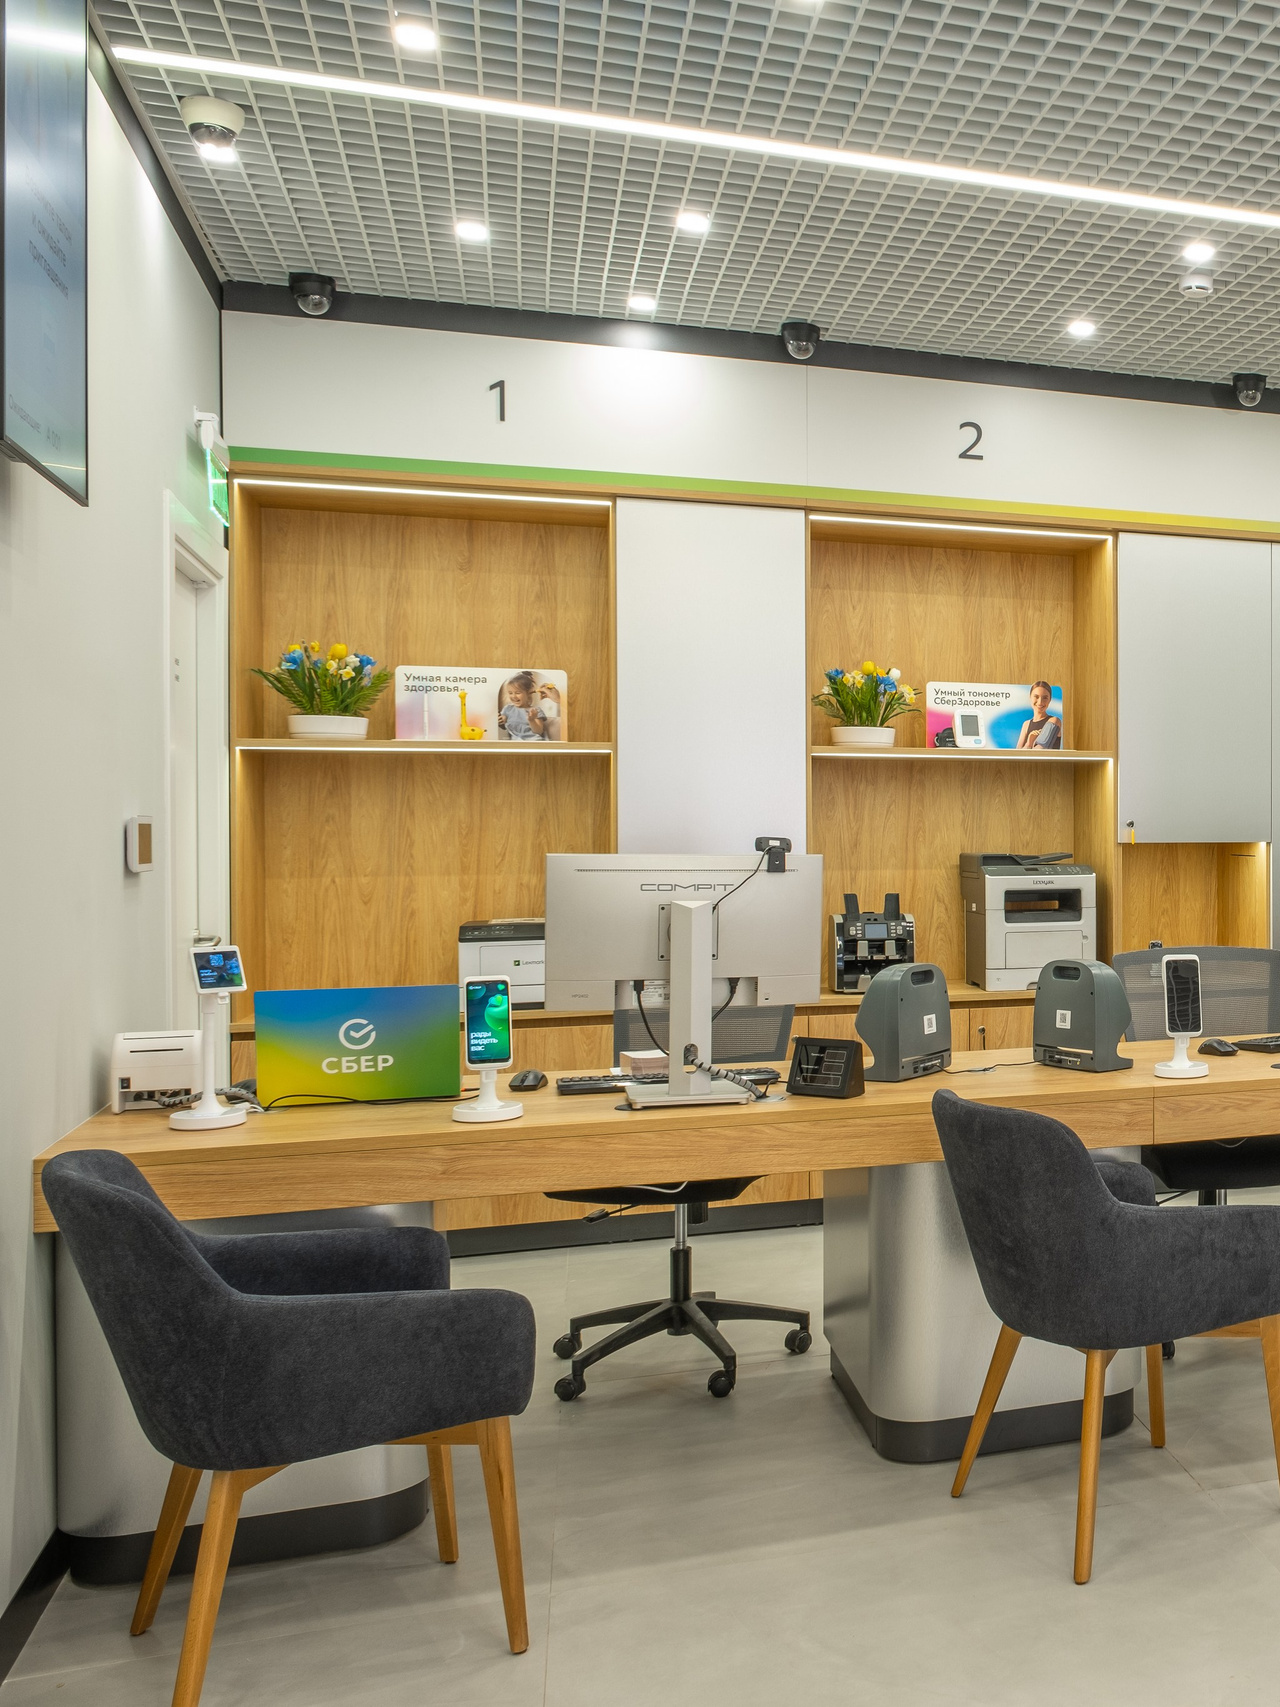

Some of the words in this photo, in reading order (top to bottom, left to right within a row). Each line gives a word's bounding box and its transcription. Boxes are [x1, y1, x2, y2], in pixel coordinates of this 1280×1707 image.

[489, 379, 505, 422] 1
[959, 421, 984, 461] 2
[404, 672, 441, 683] Умная
[445, 675, 488, 685] камера
[934, 688, 966, 697] Умный
[968, 691, 1011, 699] тонометр
[933, 697, 1001, 707] СберЗдоровье
[640, 883, 735, 892] COMPIT
[470, 1031, 492, 1039] рады
[321, 1054, 395, 1075] СБЕР
